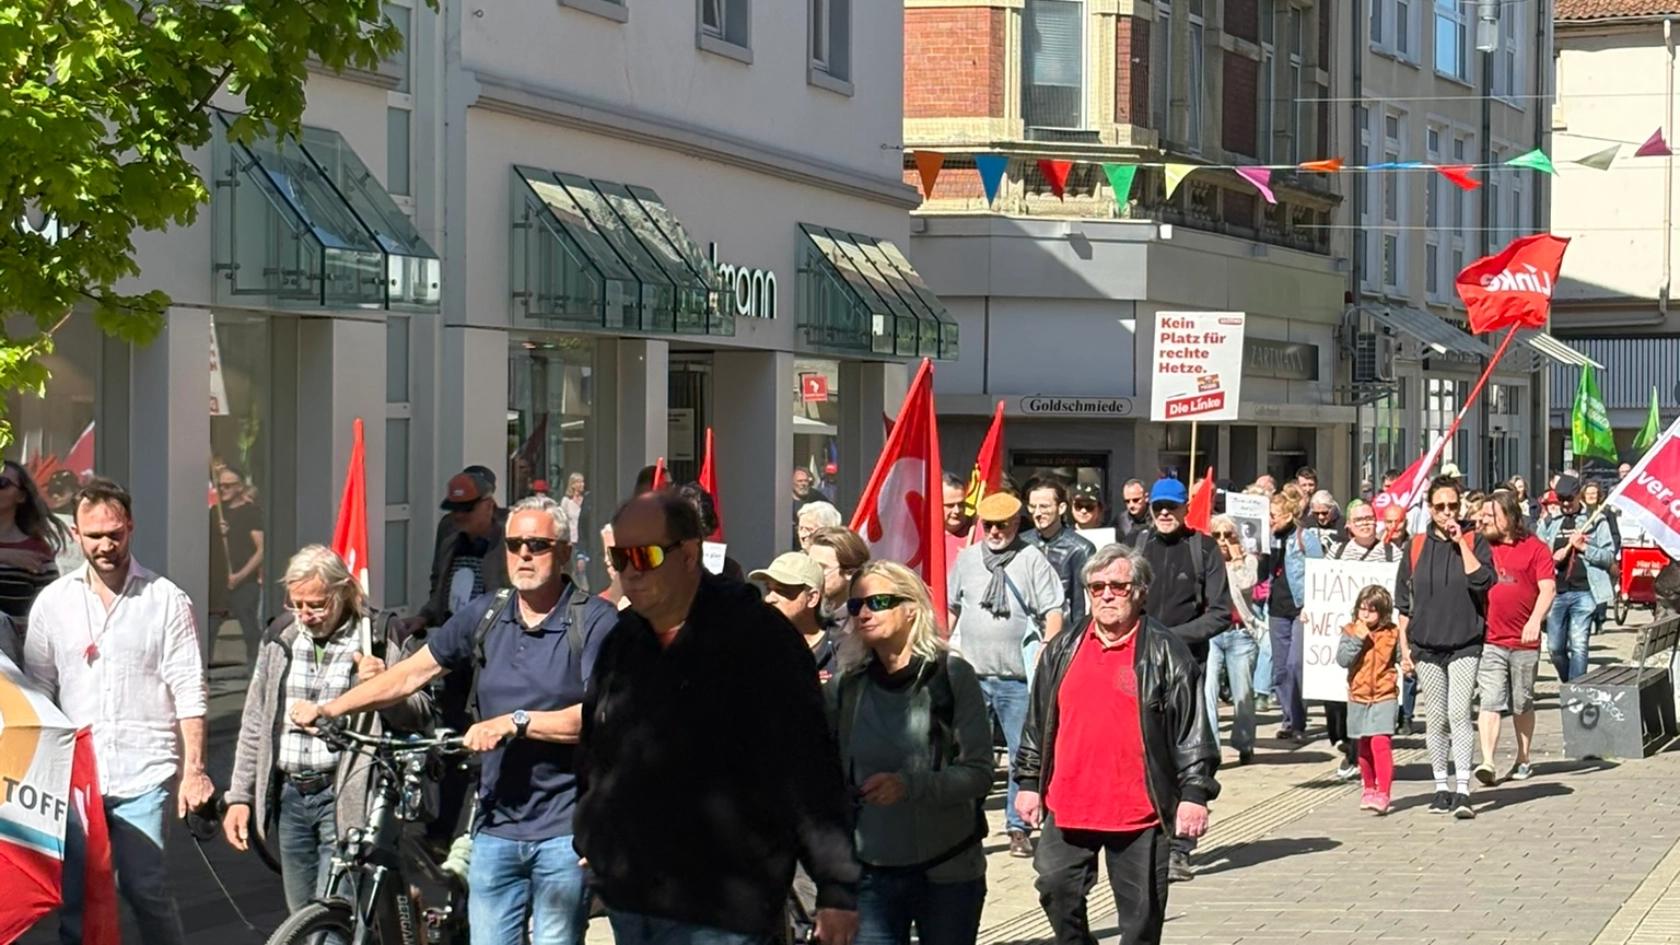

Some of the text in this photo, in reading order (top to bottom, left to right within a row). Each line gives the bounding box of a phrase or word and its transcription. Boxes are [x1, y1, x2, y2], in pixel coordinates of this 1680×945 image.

[1161, 317, 1195, 329] Kein
[1160, 332, 1226, 344] Platz für
[1159, 347, 1209, 359] rechte
[1159, 362, 1207, 374] Hetze.
[1029, 399, 1124, 413] Goldschmiede
[1169, 397, 1221, 415] Die Linke
[1312, 568, 1394, 602] HÄN
[1306, 644, 1336, 666] SO
[2, 775, 66, 822] TOFF
